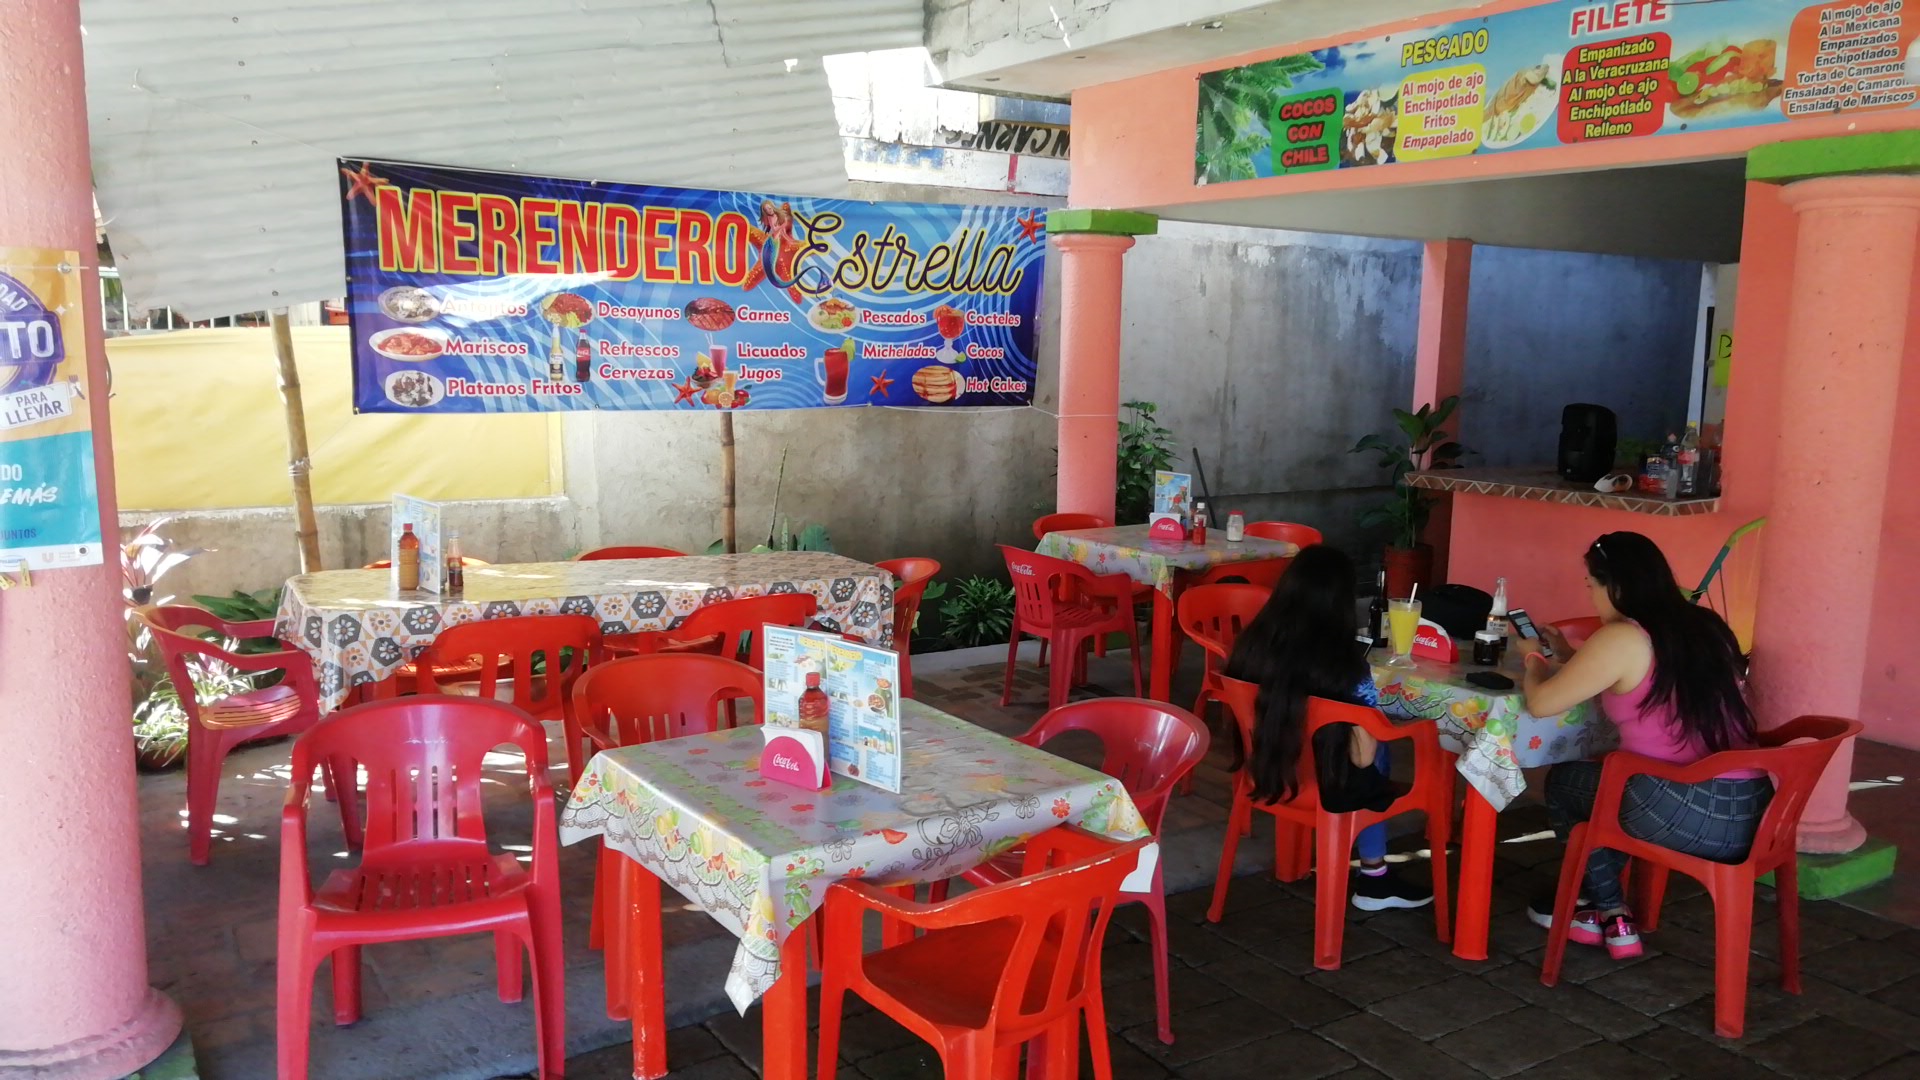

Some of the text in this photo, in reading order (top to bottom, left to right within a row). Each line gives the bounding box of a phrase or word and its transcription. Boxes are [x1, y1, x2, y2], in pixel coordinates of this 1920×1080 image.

[1571, 0, 1666, 35] FILETE
[1821, 0, 1901, 22] Al mojo de ajo
[1820, 17, 1899, 37] A la Mexicana
[1401, 29, 1488, 67] PESCADO
[1579, 38, 1655, 63] Empanizado
[1820, 32, 1897, 52] Empanizados
[1816, 47, 1898, 67] Enchipotlados
[1563, 57, 1669, 84] A la Veracruzana
[1798, 62, 1905, 84] Torta de Camarone
[1402, 72, 1484, 96] Al mojo de ajo
[1568, 77, 1659, 102] Al mojo de ajo
[1785, 78, 1910, 99] Ensalada de Camaro
[1280, 96, 1336, 121] COCOS
[1405, 91, 1480, 114] Enchipotlado
[1570, 98, 1653, 121] Enchipotlado
[1789, 92, 1915, 113] Ensalada de Mariscos
[1424, 114, 1456, 129] Fritos
[1584, 121, 1633, 138] Relleno
[1287, 123, 1324, 142] CON
[1403, 128, 1474, 149] Empapelado
[1281, 146, 1331, 167] CHILE
[376, 186, 1023, 295] MERENDERO Estrella
[0, 283, 28, 312] DAD
[598, 302, 680, 321] Desayunos
[736, 306, 790, 322] Carnes
[863, 310, 926, 325] Pescados
[966, 311, 1021, 326] Cocteles
[0, 320, 55, 358] TO
[445, 338, 527, 355] Mariscos
[599, 341, 680, 358] Refrescos
[737, 344, 806, 358] Licuados
[863, 345, 937, 358] Micheladas
[967, 345, 1004, 358] Cocos
[599, 366, 675, 379] Cervezas
[739, 366, 782, 383] Jugos
[448, 379, 582, 397] Platanos Fritos
[966, 378, 1027, 393] Hot Cakes
[15, 391, 48, 408] PARA
[5, 400, 64, 426] LLEVAR
[0, 464, 23, 482] DO
[0, 482, 58, 507] EMÁS
